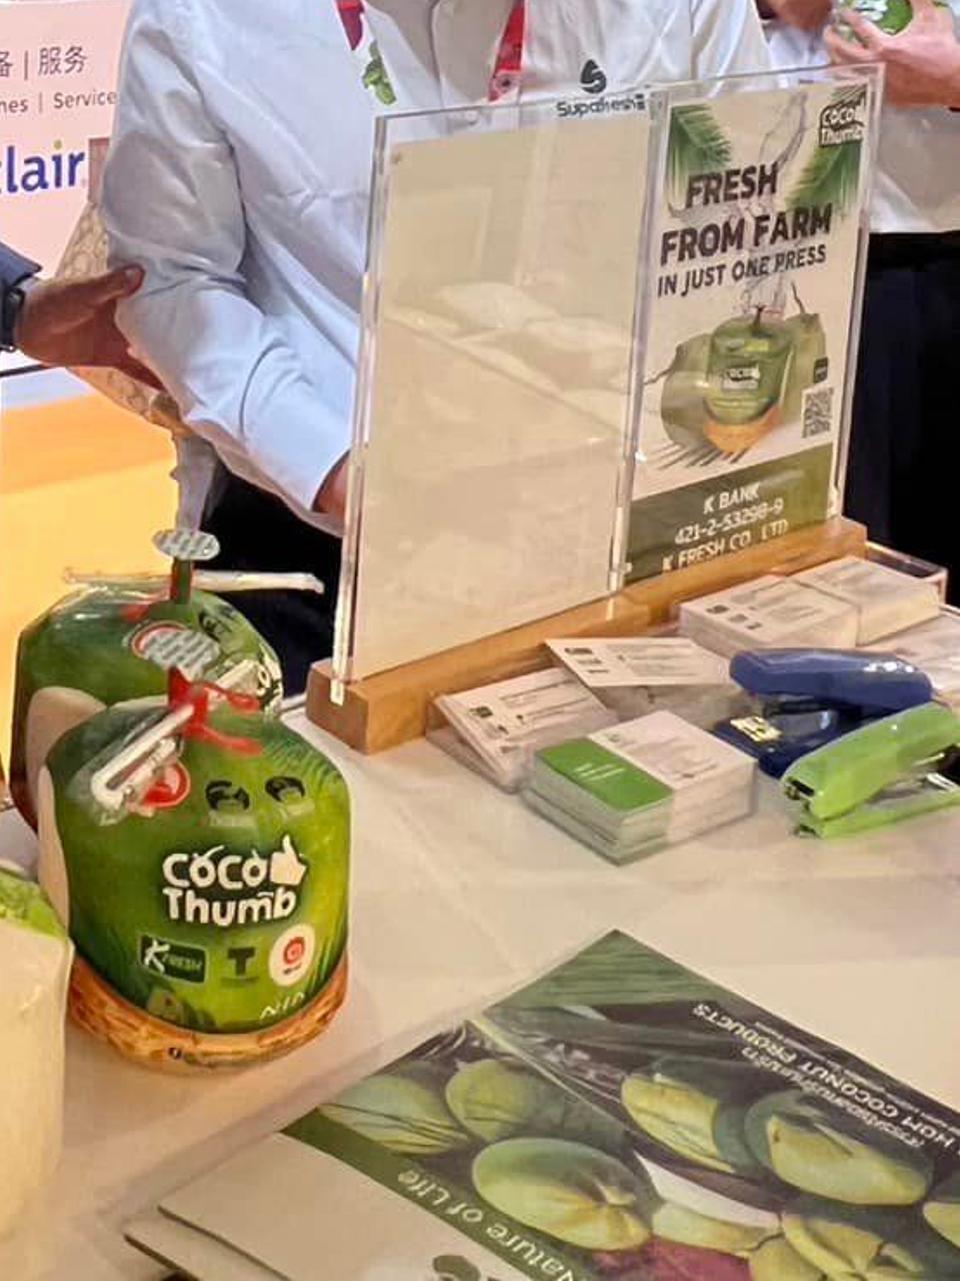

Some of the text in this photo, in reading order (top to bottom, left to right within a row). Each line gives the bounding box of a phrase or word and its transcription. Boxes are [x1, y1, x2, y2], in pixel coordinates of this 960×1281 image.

[38, 45, 88, 76] 服务
[684, 161, 779, 209] FRESH
[659, 202, 834, 267] FROM FARM
[657, 244, 828, 298] IN JUST ONE PRESS
[702, 483, 762, 515] K BANK
[677, 538, 726, 569] FRESH
[162, 885, 297, 927] Thumb
[692, 1002, 798, 1064] PRODUCTS
[800, 1061, 901, 1120] COCONUT
